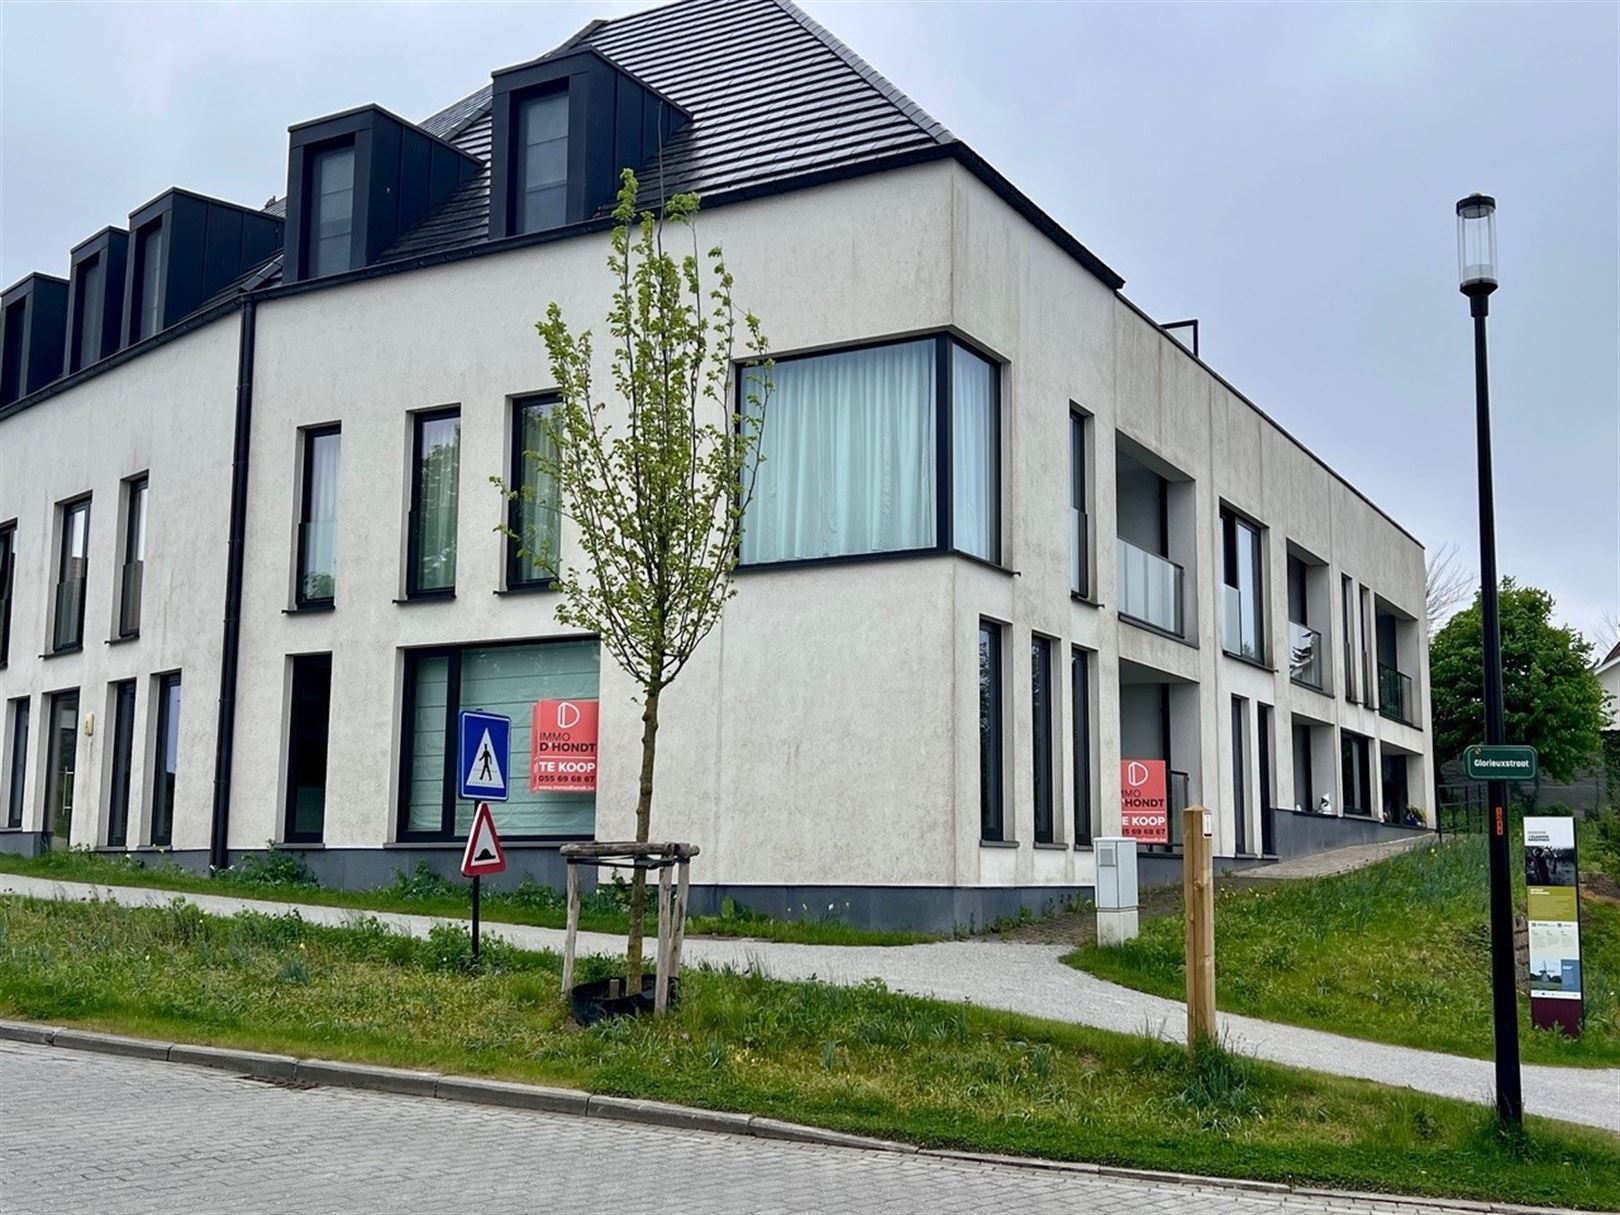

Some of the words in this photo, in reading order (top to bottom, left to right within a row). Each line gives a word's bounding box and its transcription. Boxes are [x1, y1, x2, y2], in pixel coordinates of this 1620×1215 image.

[540, 732, 571, 741] IMMO
[540, 742, 596, 752] D'HONDT
[539, 762, 555, 772] TE
[559, 762, 596, 772] KOOP
[1474, 759, 1529, 767] Glorieuxstraat
[570, 775, 582, 783] 68
[584, 775, 595, 783] 67
[1121, 789, 1141, 798] MO
[1122, 798, 1164, 808] 'HONDT
[1122, 816, 1129, 826] E
[1132, 816, 1166, 826] KOOP
